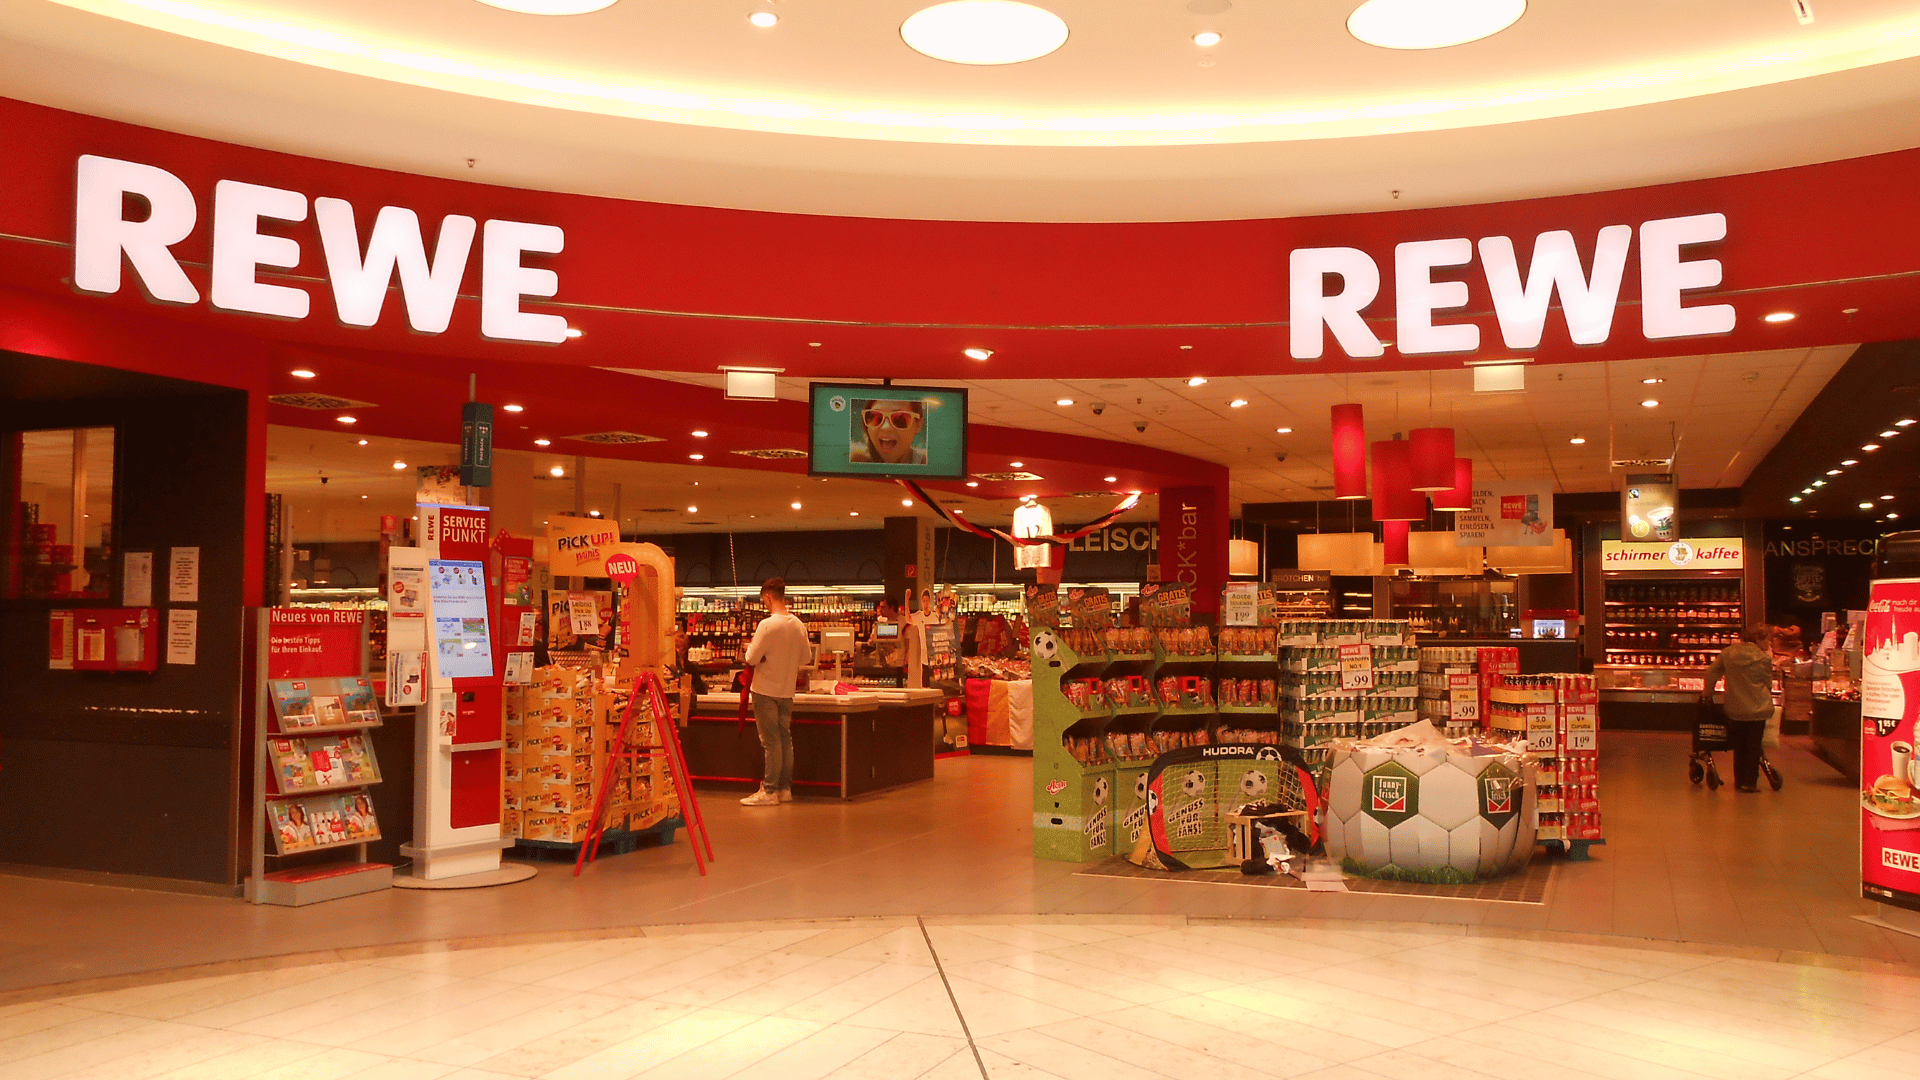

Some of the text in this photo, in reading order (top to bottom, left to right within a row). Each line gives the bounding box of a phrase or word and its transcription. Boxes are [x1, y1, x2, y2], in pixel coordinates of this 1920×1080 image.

[75, 154, 568, 344] REWE
[1289, 212, 1737, 359] REWE
[427, 514, 435, 540] REWE
[443, 515, 486, 529] SERVICE
[442, 527, 486, 543] PUNKT
[590, 532, 614, 546] UP!
[1606, 547, 1740, 561] schirmer kaffee
[607, 561, 637, 575] NEU!
[1084, 594, 1108, 607] GRATIS
[1157, 588, 1187, 601] GRATIS
[272, 610, 362, 623] Neues von REWE
[283, 636, 304, 644] besten
[304, 636, 321, 645] Tipps
[271, 645, 281, 653] für
[281, 645, 298, 653] Ihren
[1203, 746, 1254, 757] HUDORA
[1379, 778, 1402, 789] funny-
[1378, 789, 1400, 799] frisch
[1168, 798, 1204, 823] GENUSS
[1084, 805, 1107, 835] GENUSS
[1180, 812, 1199, 825] FÜR
[1092, 820, 1104, 836] FÜR
[1177, 823, 1202, 838] FANS!
[1090, 830, 1106, 850] FANS!
[1884, 850, 1920, 870] REWE
